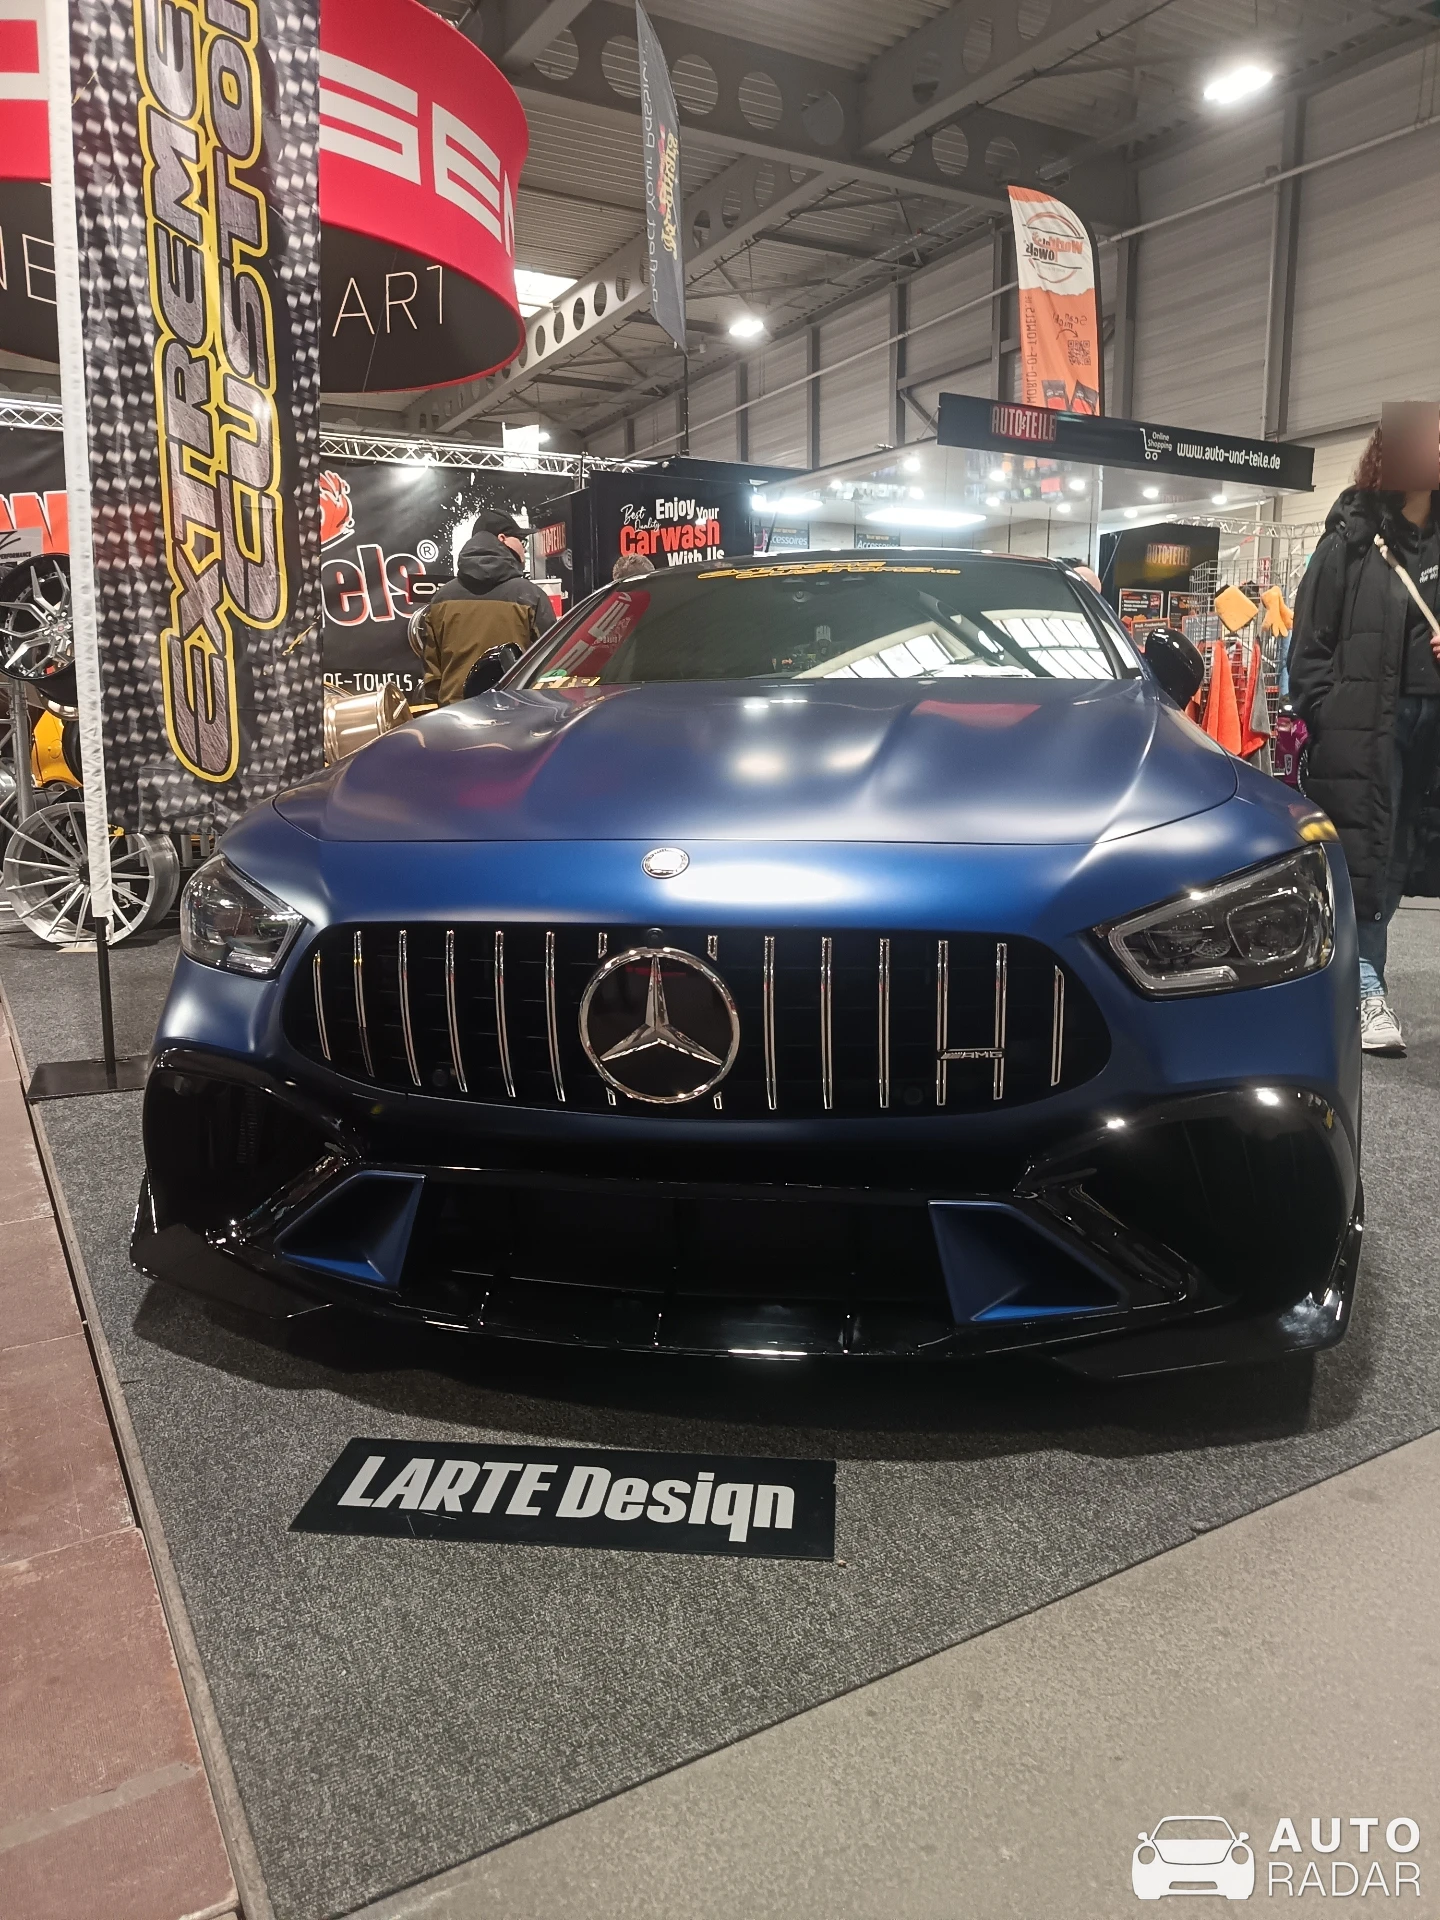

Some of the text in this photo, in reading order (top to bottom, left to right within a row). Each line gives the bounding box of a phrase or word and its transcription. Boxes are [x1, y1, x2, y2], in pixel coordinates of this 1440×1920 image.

[202, 0, 285, 626] CUSTO
[137, 0, 236, 780] EXTREME
[1147, 439, 1173, 452] Shopping
[1152, 431, 1170, 441] Online
[1176, 442, 1281, 470] www.auto-und-teile.de
[620, 503, 647, 525] Best
[655, 497, 720, 522] Enjoy Your
[620, 518, 720, 557] Carwash
[634, 517, 661, 533] Quality
[763, 533, 808, 546] Acessoires
[667, 546, 725, 567] With Us
[321, 543, 428, 627] els
[337, 1455, 558, 1516] LARTE
